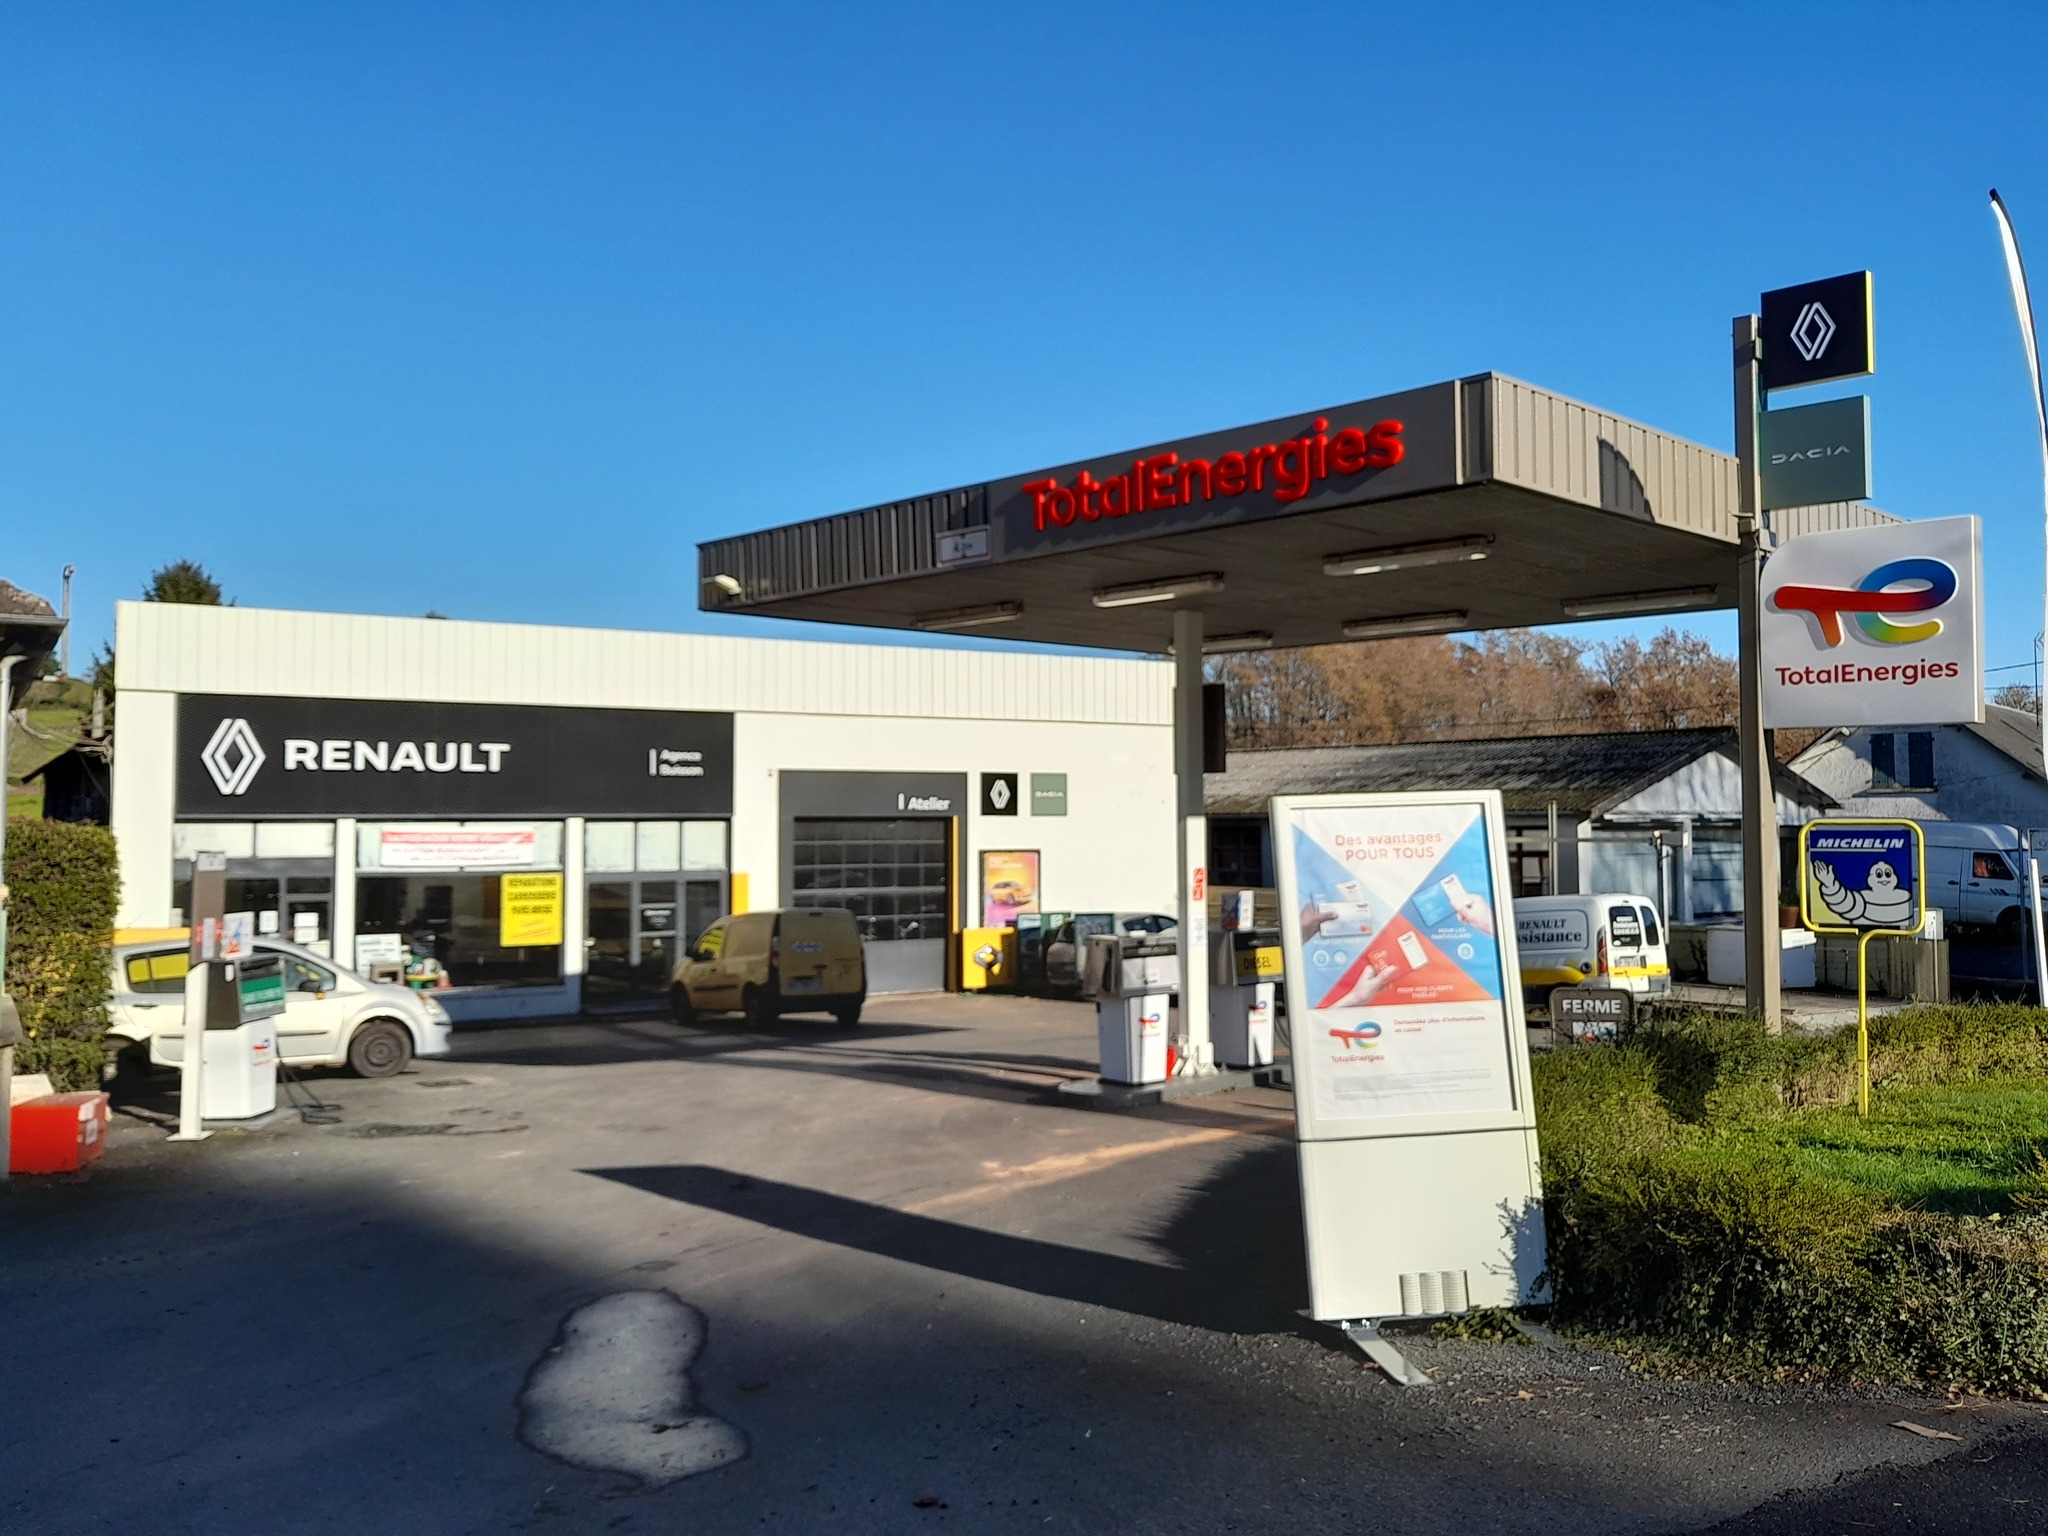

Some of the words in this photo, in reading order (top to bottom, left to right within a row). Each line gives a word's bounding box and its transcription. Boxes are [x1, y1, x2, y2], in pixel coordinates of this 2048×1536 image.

[1771, 445, 1850, 464] DACIA
[1021, 416, 1405, 532] TotalEnergies
[1775, 658, 1959, 686] TotalEnergies
[284, 738, 512, 773] RENAULT
[907, 797, 951, 811] Atelier
[1334, 833, 1362, 847] Des
[1366, 831, 1442, 847] avantages
[1816, 838, 1905, 849] MICHELIN
[1345, 848, 1390, 861] POUR
[1393, 846, 1435, 860] TOUS
[1518, 919, 1567, 930] RENAULT
[1243, 955, 1272, 969] DIESEL
[1562, 999, 1622, 1014] FERME
[1331, 1054, 1385, 1064] TotalEnergies
